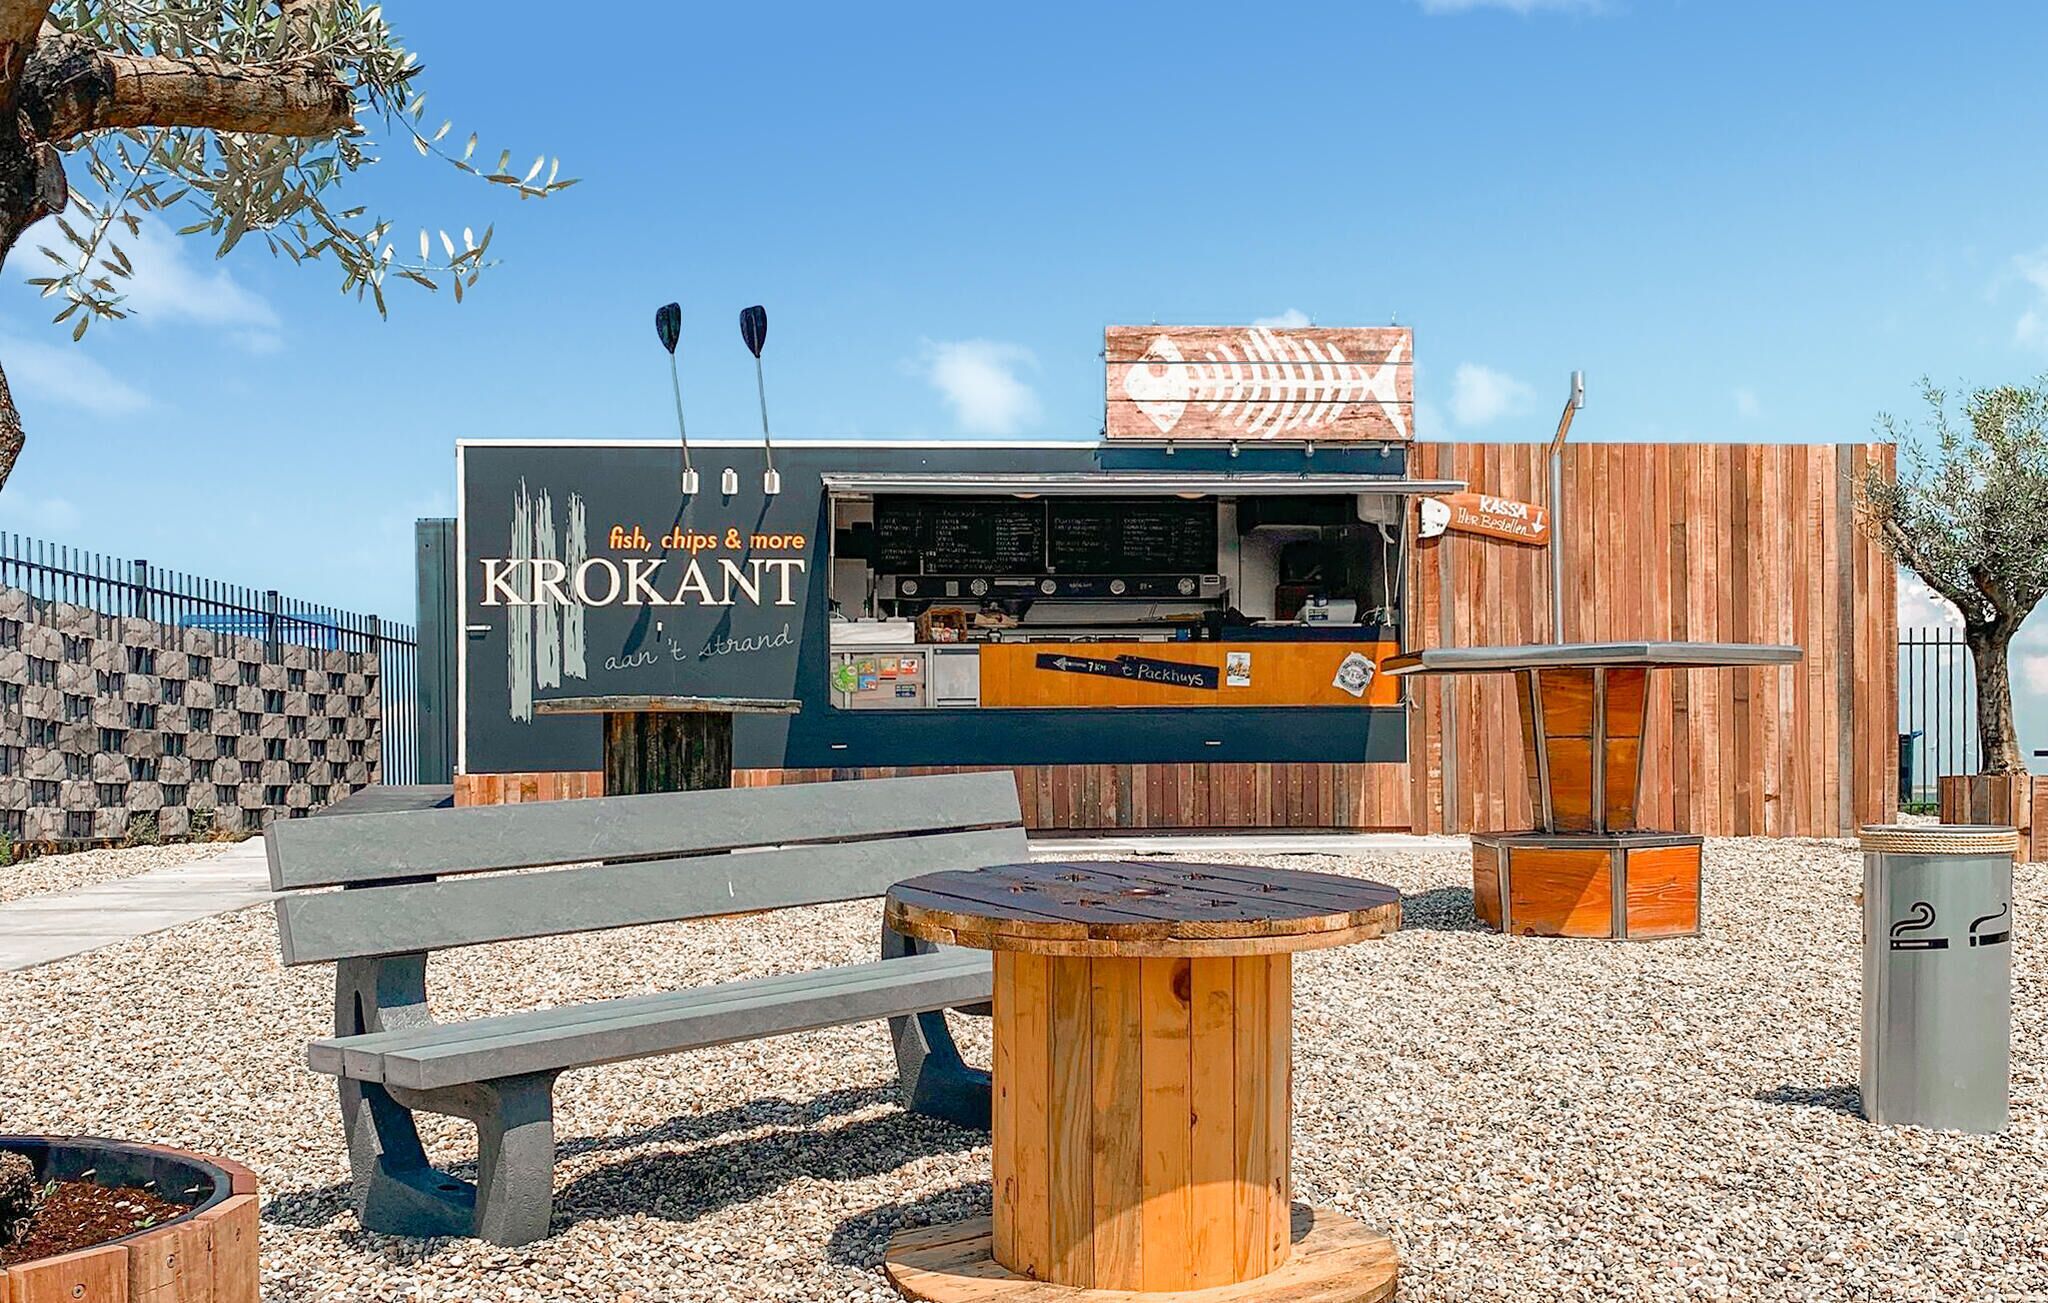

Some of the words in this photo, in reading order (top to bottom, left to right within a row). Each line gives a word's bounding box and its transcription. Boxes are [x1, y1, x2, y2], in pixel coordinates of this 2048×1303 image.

[1479, 495, 1528, 520] KASSA
[609, 524, 653, 554] fish,
[661, 525, 718, 555] chips
[724, 527, 743, 550] &
[750, 531, 807, 551] more
[479, 557, 807, 607] KROKANT
[604, 648, 659, 671] aan
[668, 637, 687, 661] 't
[698, 622, 795, 659] strand
[1087, 661, 1094, 673] 7
[1137, 663, 1205, 687] Packhuys
